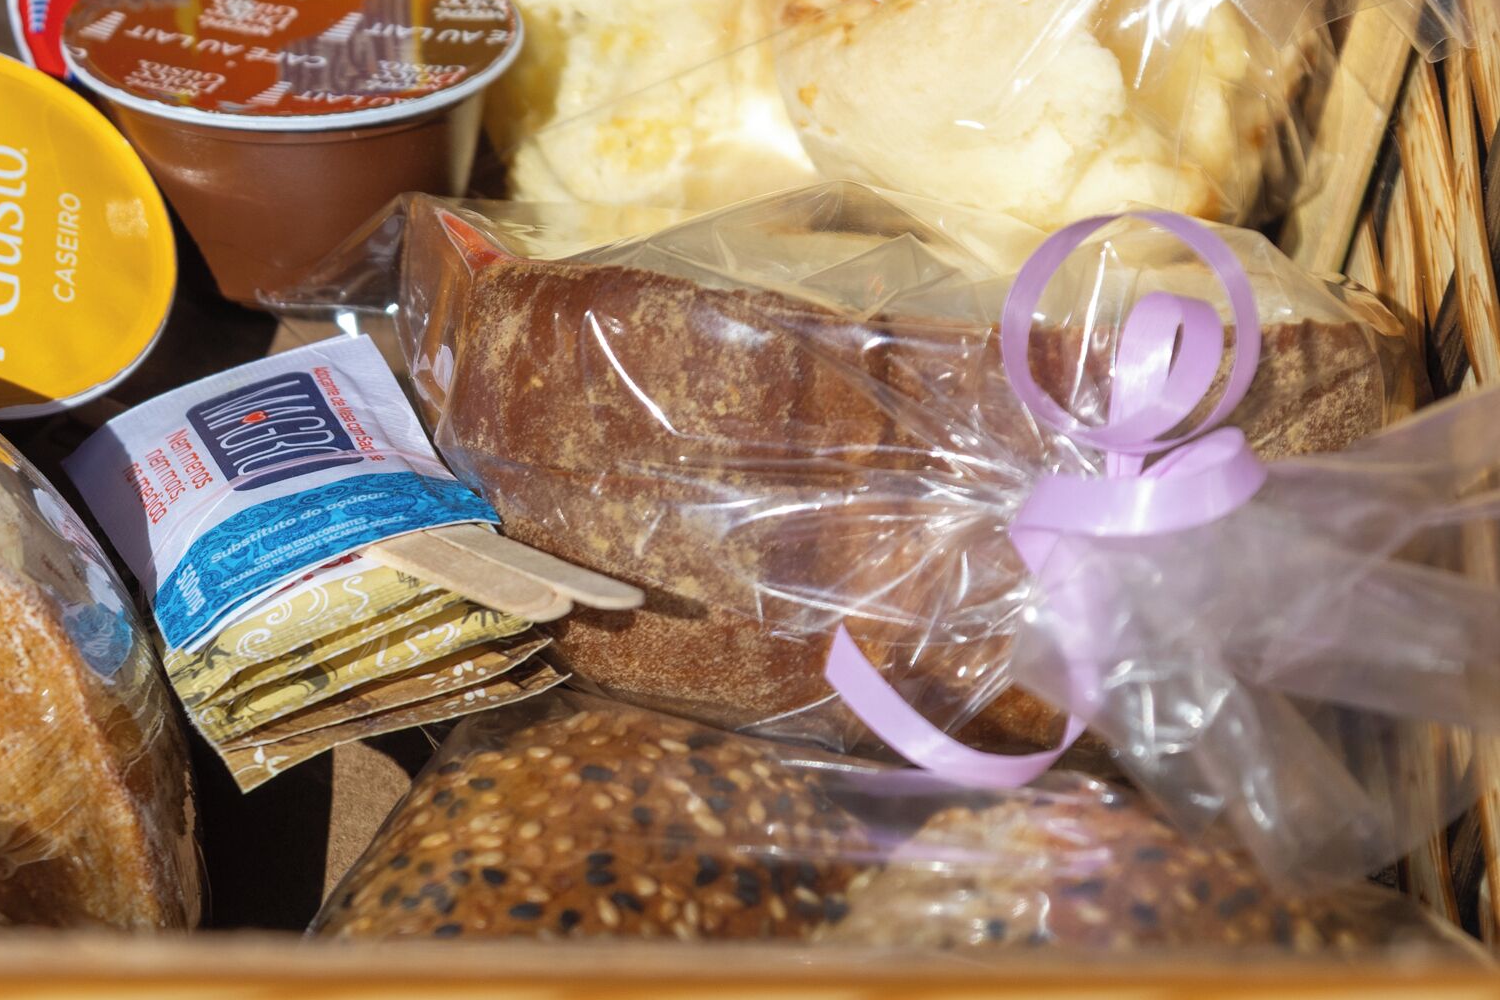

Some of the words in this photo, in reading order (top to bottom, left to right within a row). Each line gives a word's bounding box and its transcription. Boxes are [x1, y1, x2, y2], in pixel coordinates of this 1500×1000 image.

[123, 25, 196, 48] LAIT
[196, 39, 245, 56] AU
[363, 21, 435, 42] LAIT
[436, 28, 485, 45] AU
[293, 89, 363, 106] LAIT
[52, 192, 82, 303] CASEIRO
[165, 427, 194, 458] Nem
[199, 379, 350, 478] MAGRO
[144, 447, 172, 475] nem
[179, 451, 214, 490] menos
[131, 475, 169, 526] medida
[156, 469, 189, 505] mais,
[210, 516, 297, 564] Substituto
[299, 507, 322, 520] do
[270, 556, 286, 567] DE
[323, 523, 371, 545] SACARINA
[292, 516, 368, 549] EDULCORANTES
[175, 563, 207, 617] 500mg
